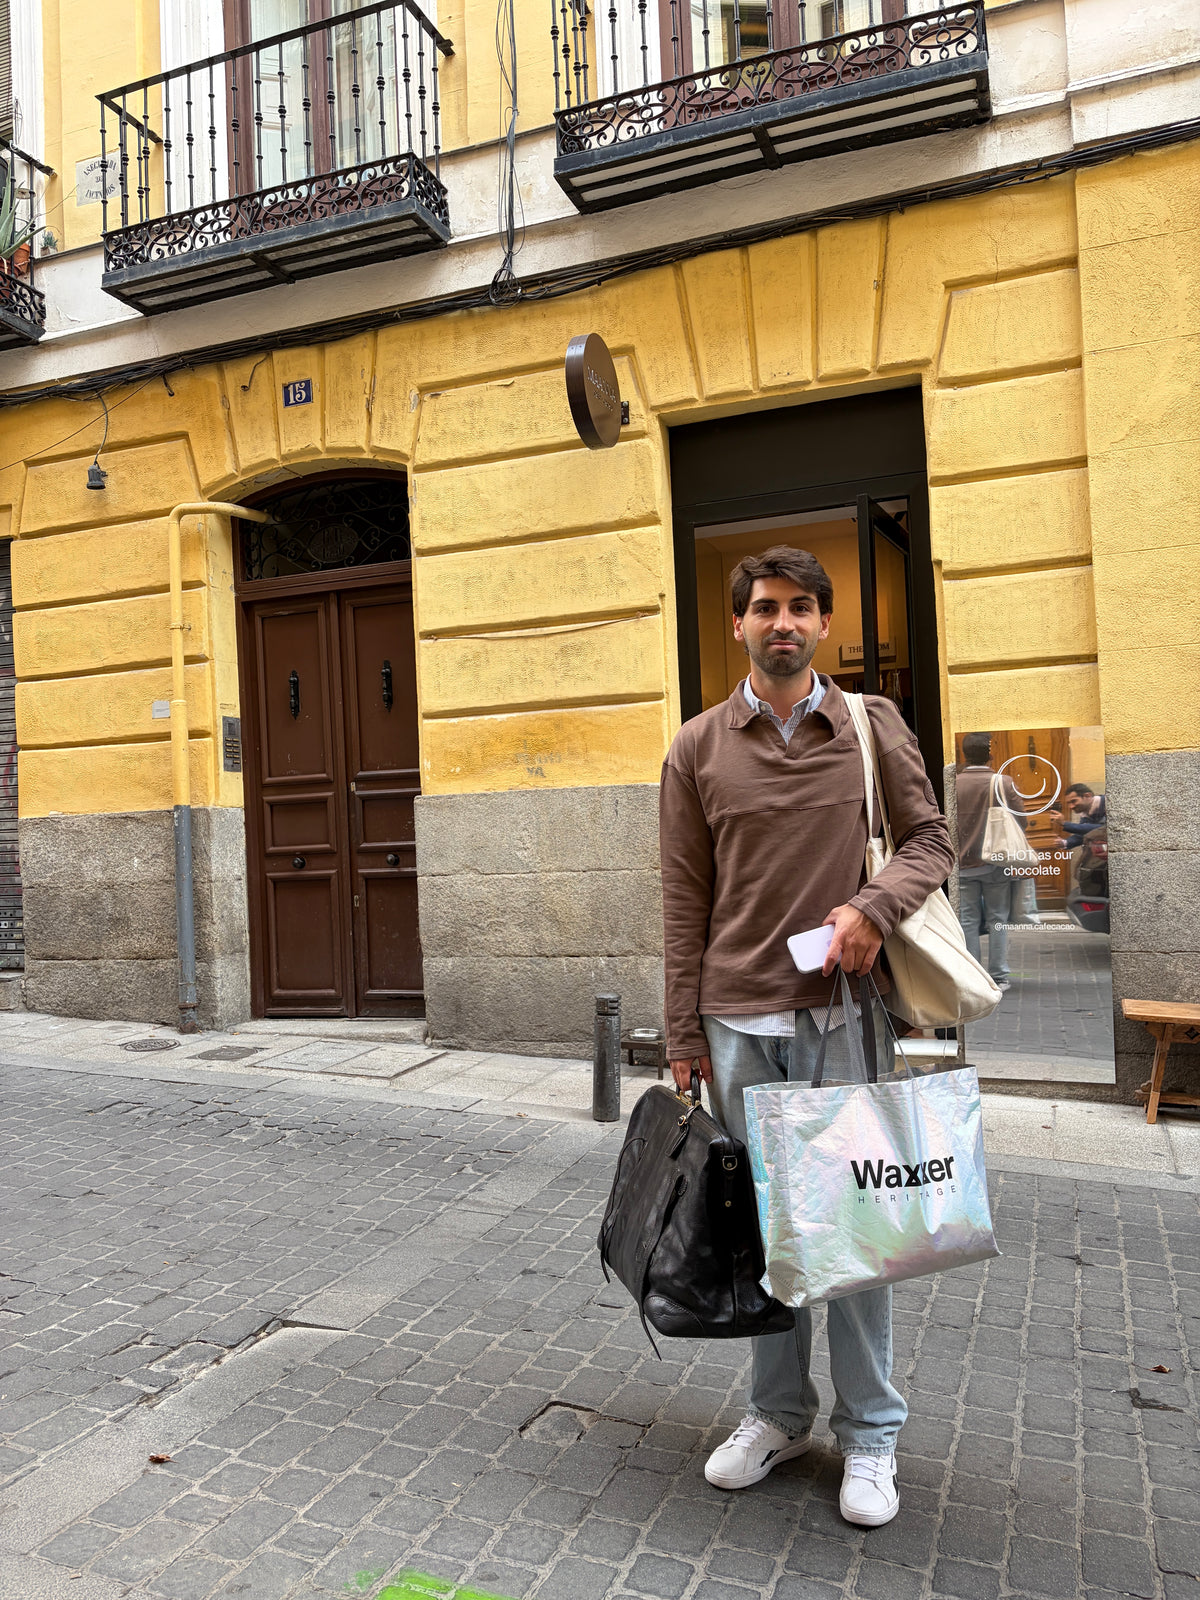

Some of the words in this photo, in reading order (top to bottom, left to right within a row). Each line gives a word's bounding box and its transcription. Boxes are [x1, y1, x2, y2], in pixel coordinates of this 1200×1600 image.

[287, 382, 306, 405] 15
[847, 645, 864, 654] THE
[990, 851, 1005, 862] as
[1006, 849, 1034, 861] HOT
[1037, 850, 1052, 860] as
[1053, 850, 1074, 860] our
[1003, 864, 1061, 877] chocolate
[994, 921, 1076, 932] @maanna.cafecacao
[850, 1155, 955, 1190] Waxxer
[857, 1184, 957, 1205] HERITAGE
